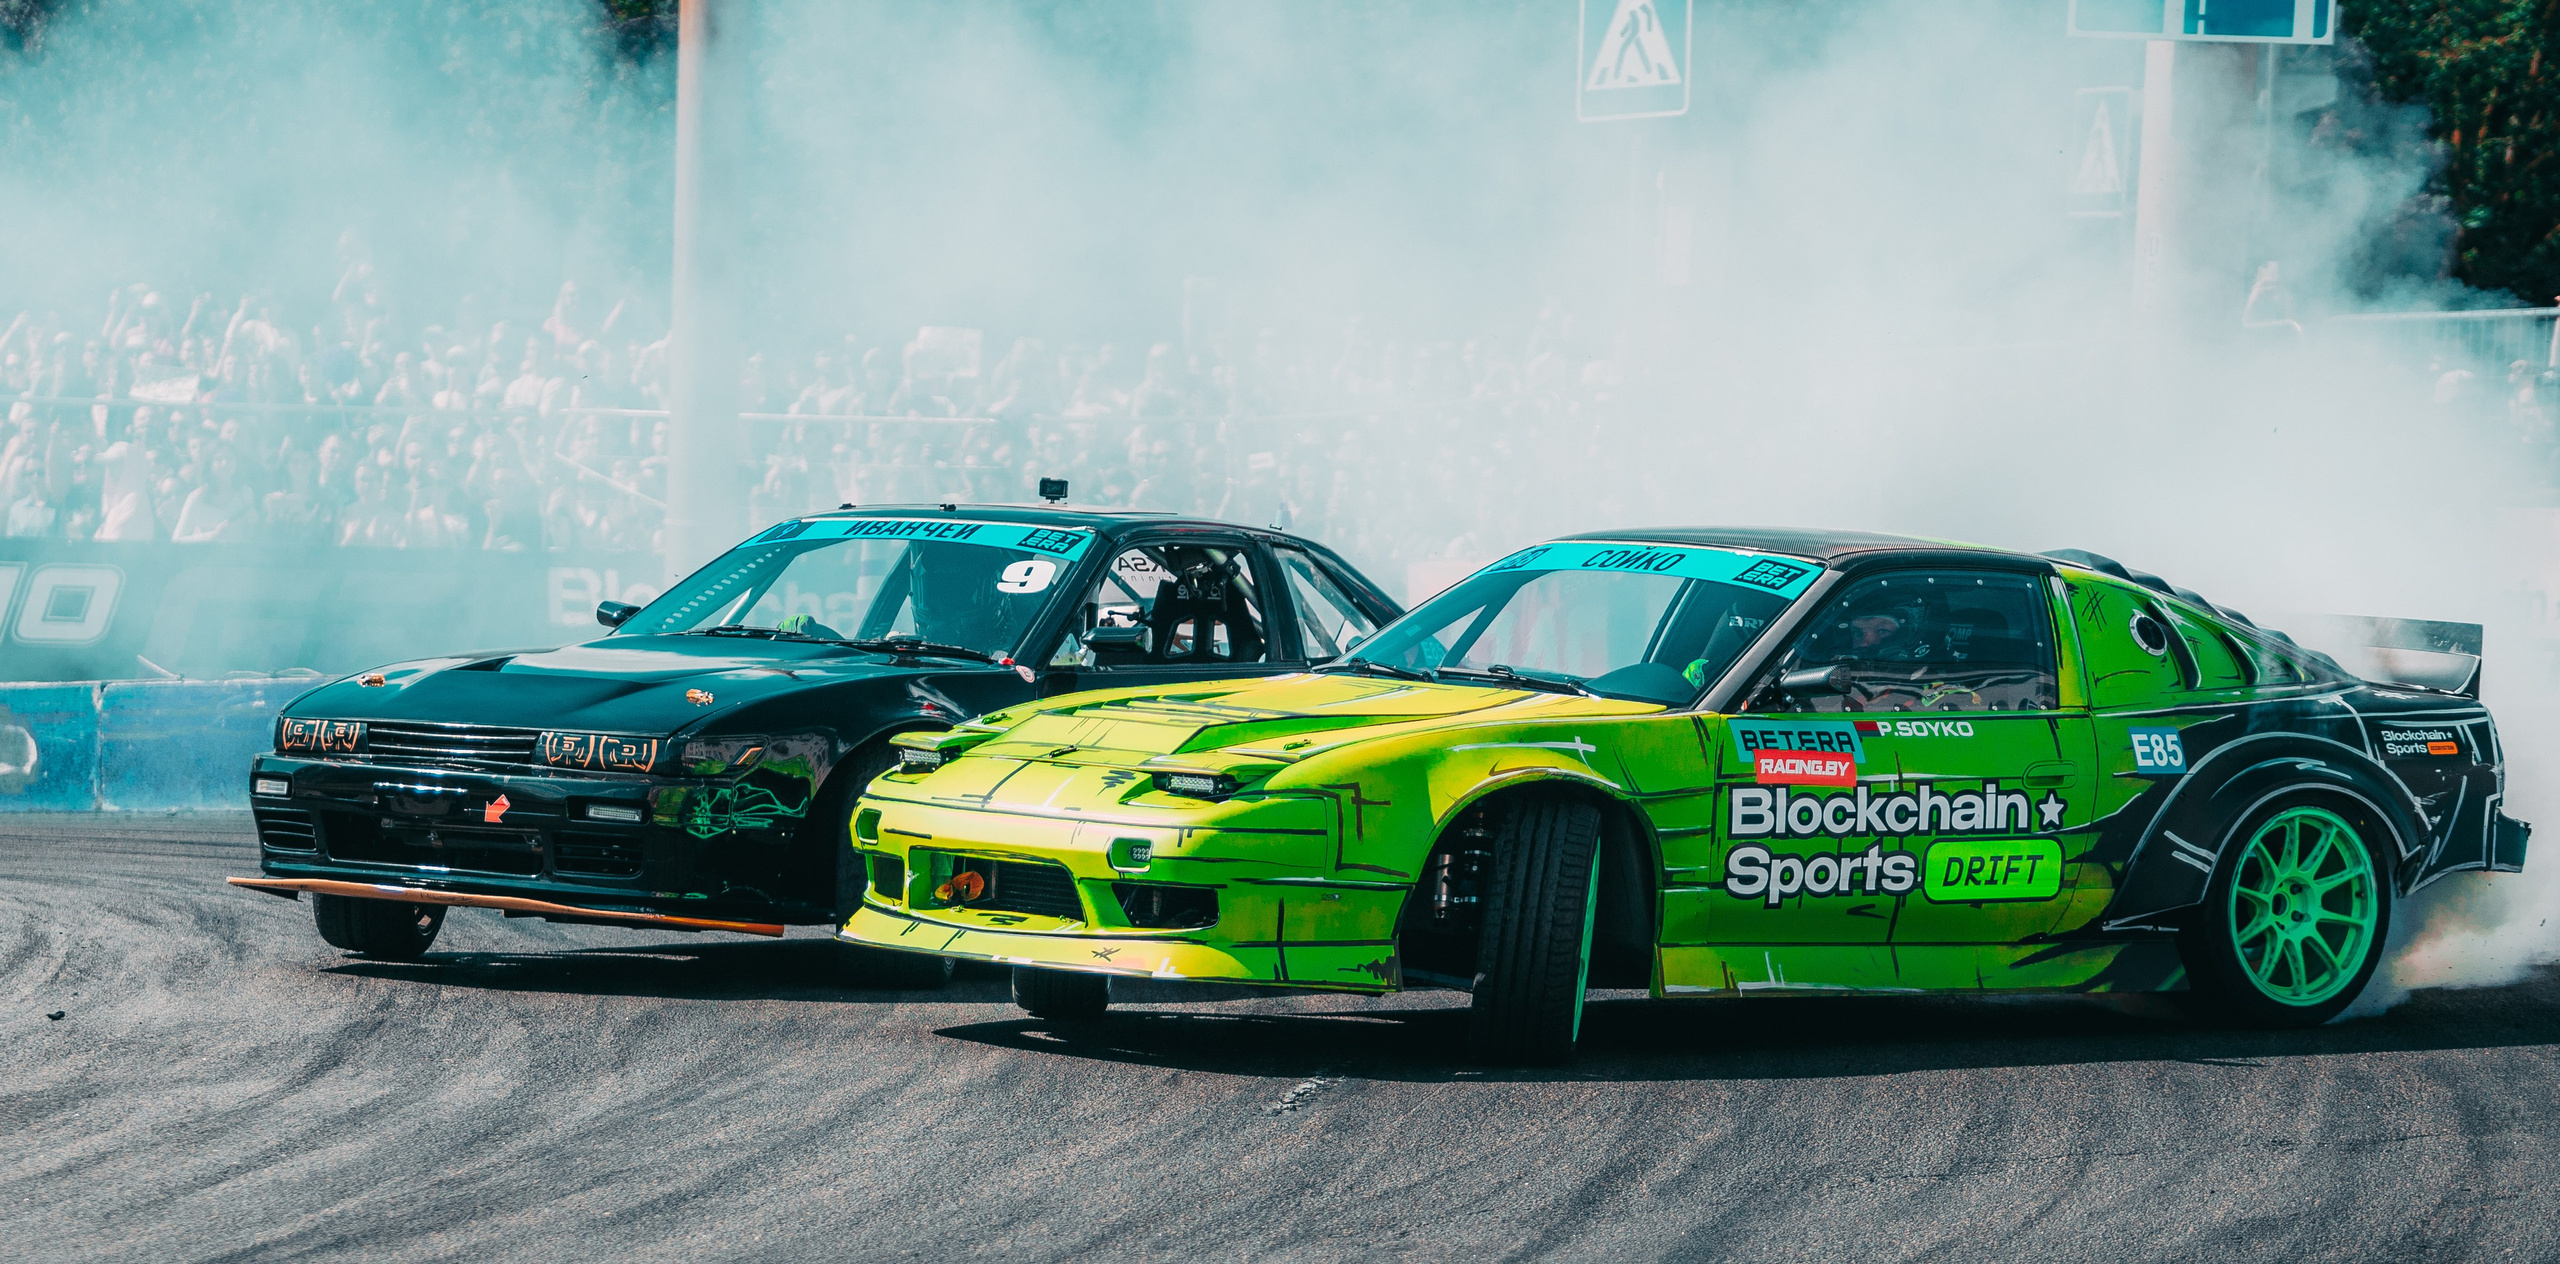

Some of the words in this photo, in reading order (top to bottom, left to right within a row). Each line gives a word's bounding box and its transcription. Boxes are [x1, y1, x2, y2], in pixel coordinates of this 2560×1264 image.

[1033, 529, 1080, 543] BET
[1581, 546, 1687, 572] СОЙКО
[996, 560, 1057, 594] 9
[1753, 561, 1802, 579] BET
[1879, 721, 1974, 737] P.SOYKO
[2381, 729, 2447, 742] Blockchain
[2131, 733, 2183, 767] E85
[2385, 742, 2428, 756] Sports
[1759, 758, 1850, 777] RACING.BY
[1731, 784, 2029, 835] Blockchain
[1726, 844, 1916, 905] Sports
[1942, 853, 2045, 888] DRIFT
